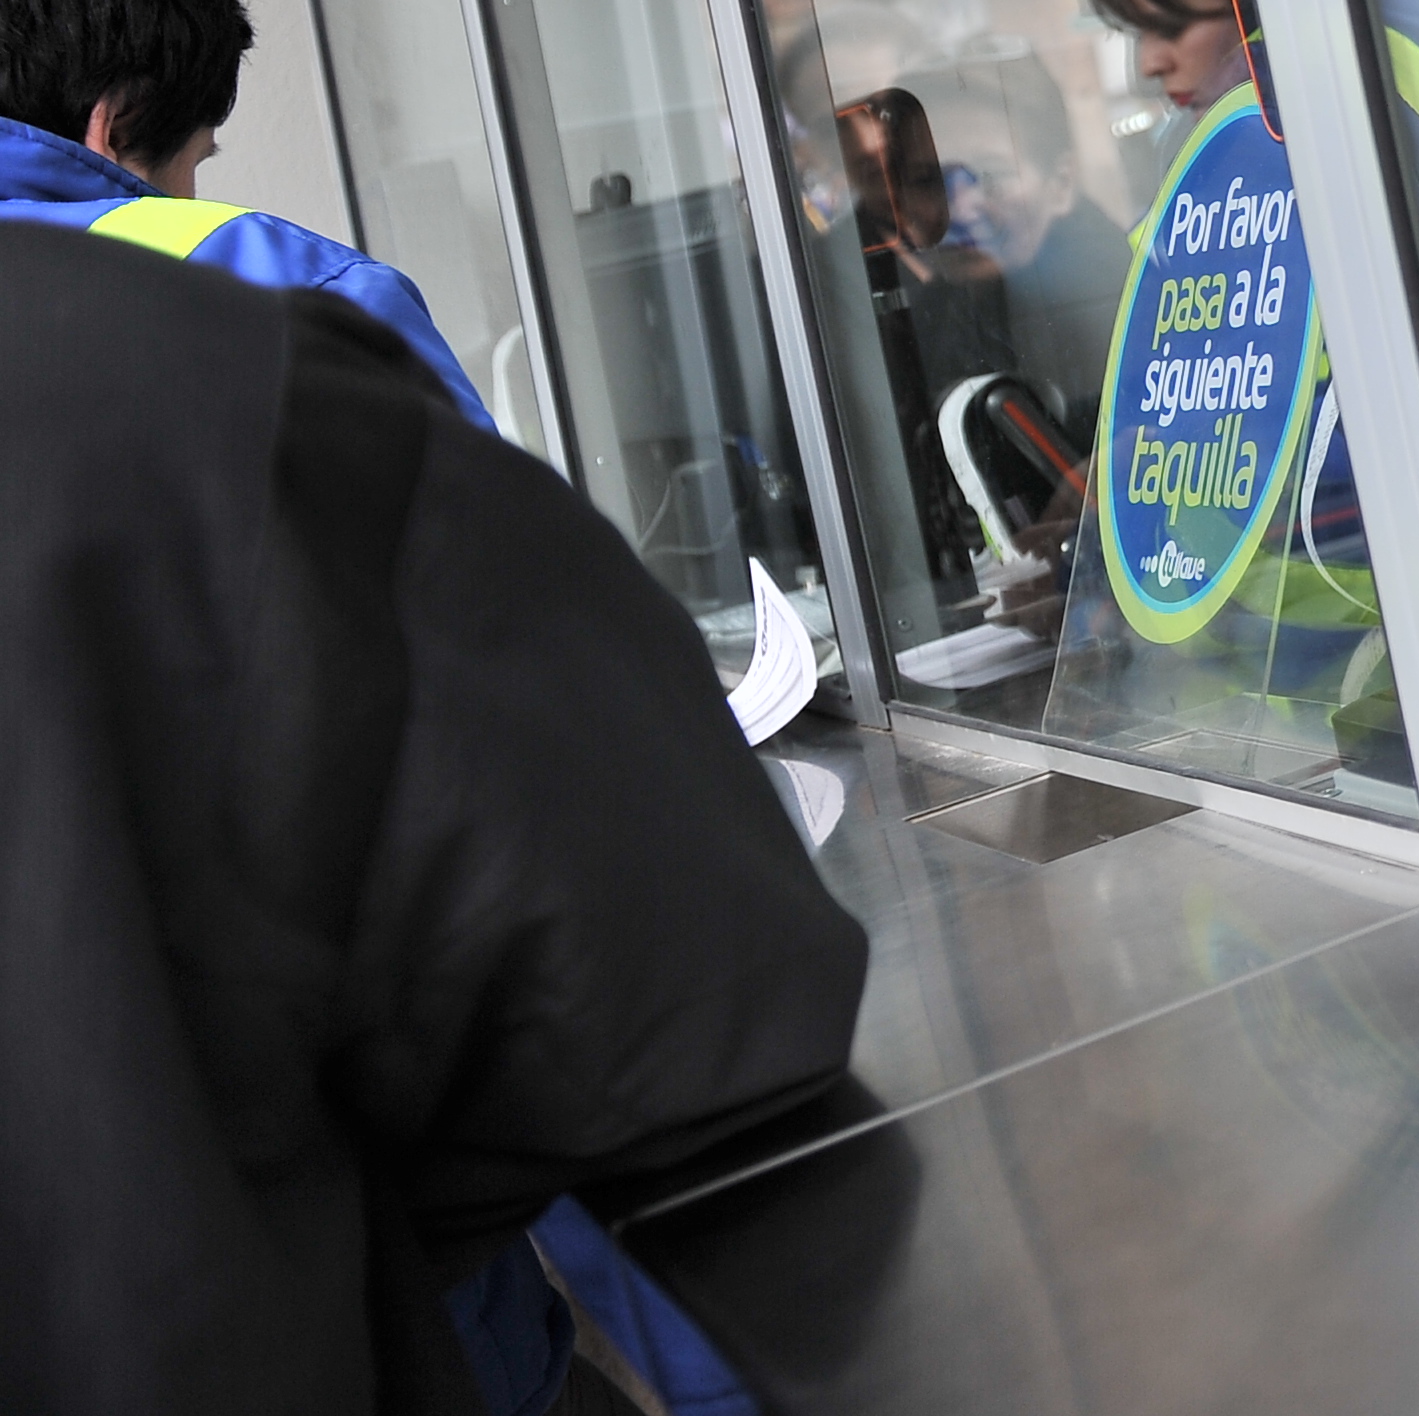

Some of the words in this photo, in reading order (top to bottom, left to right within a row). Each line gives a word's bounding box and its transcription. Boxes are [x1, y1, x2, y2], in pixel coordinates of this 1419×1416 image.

[1168, 193, 1221, 257] Por
[1219, 176, 1296, 251] favor
[1153, 272, 1227, 351] pasa
[1228, 268, 1251, 329] a
[1254, 244, 1287, 326] la
[1140, 339, 1274, 428] siguiente
[1127, 413, 1258, 526] taquilla
